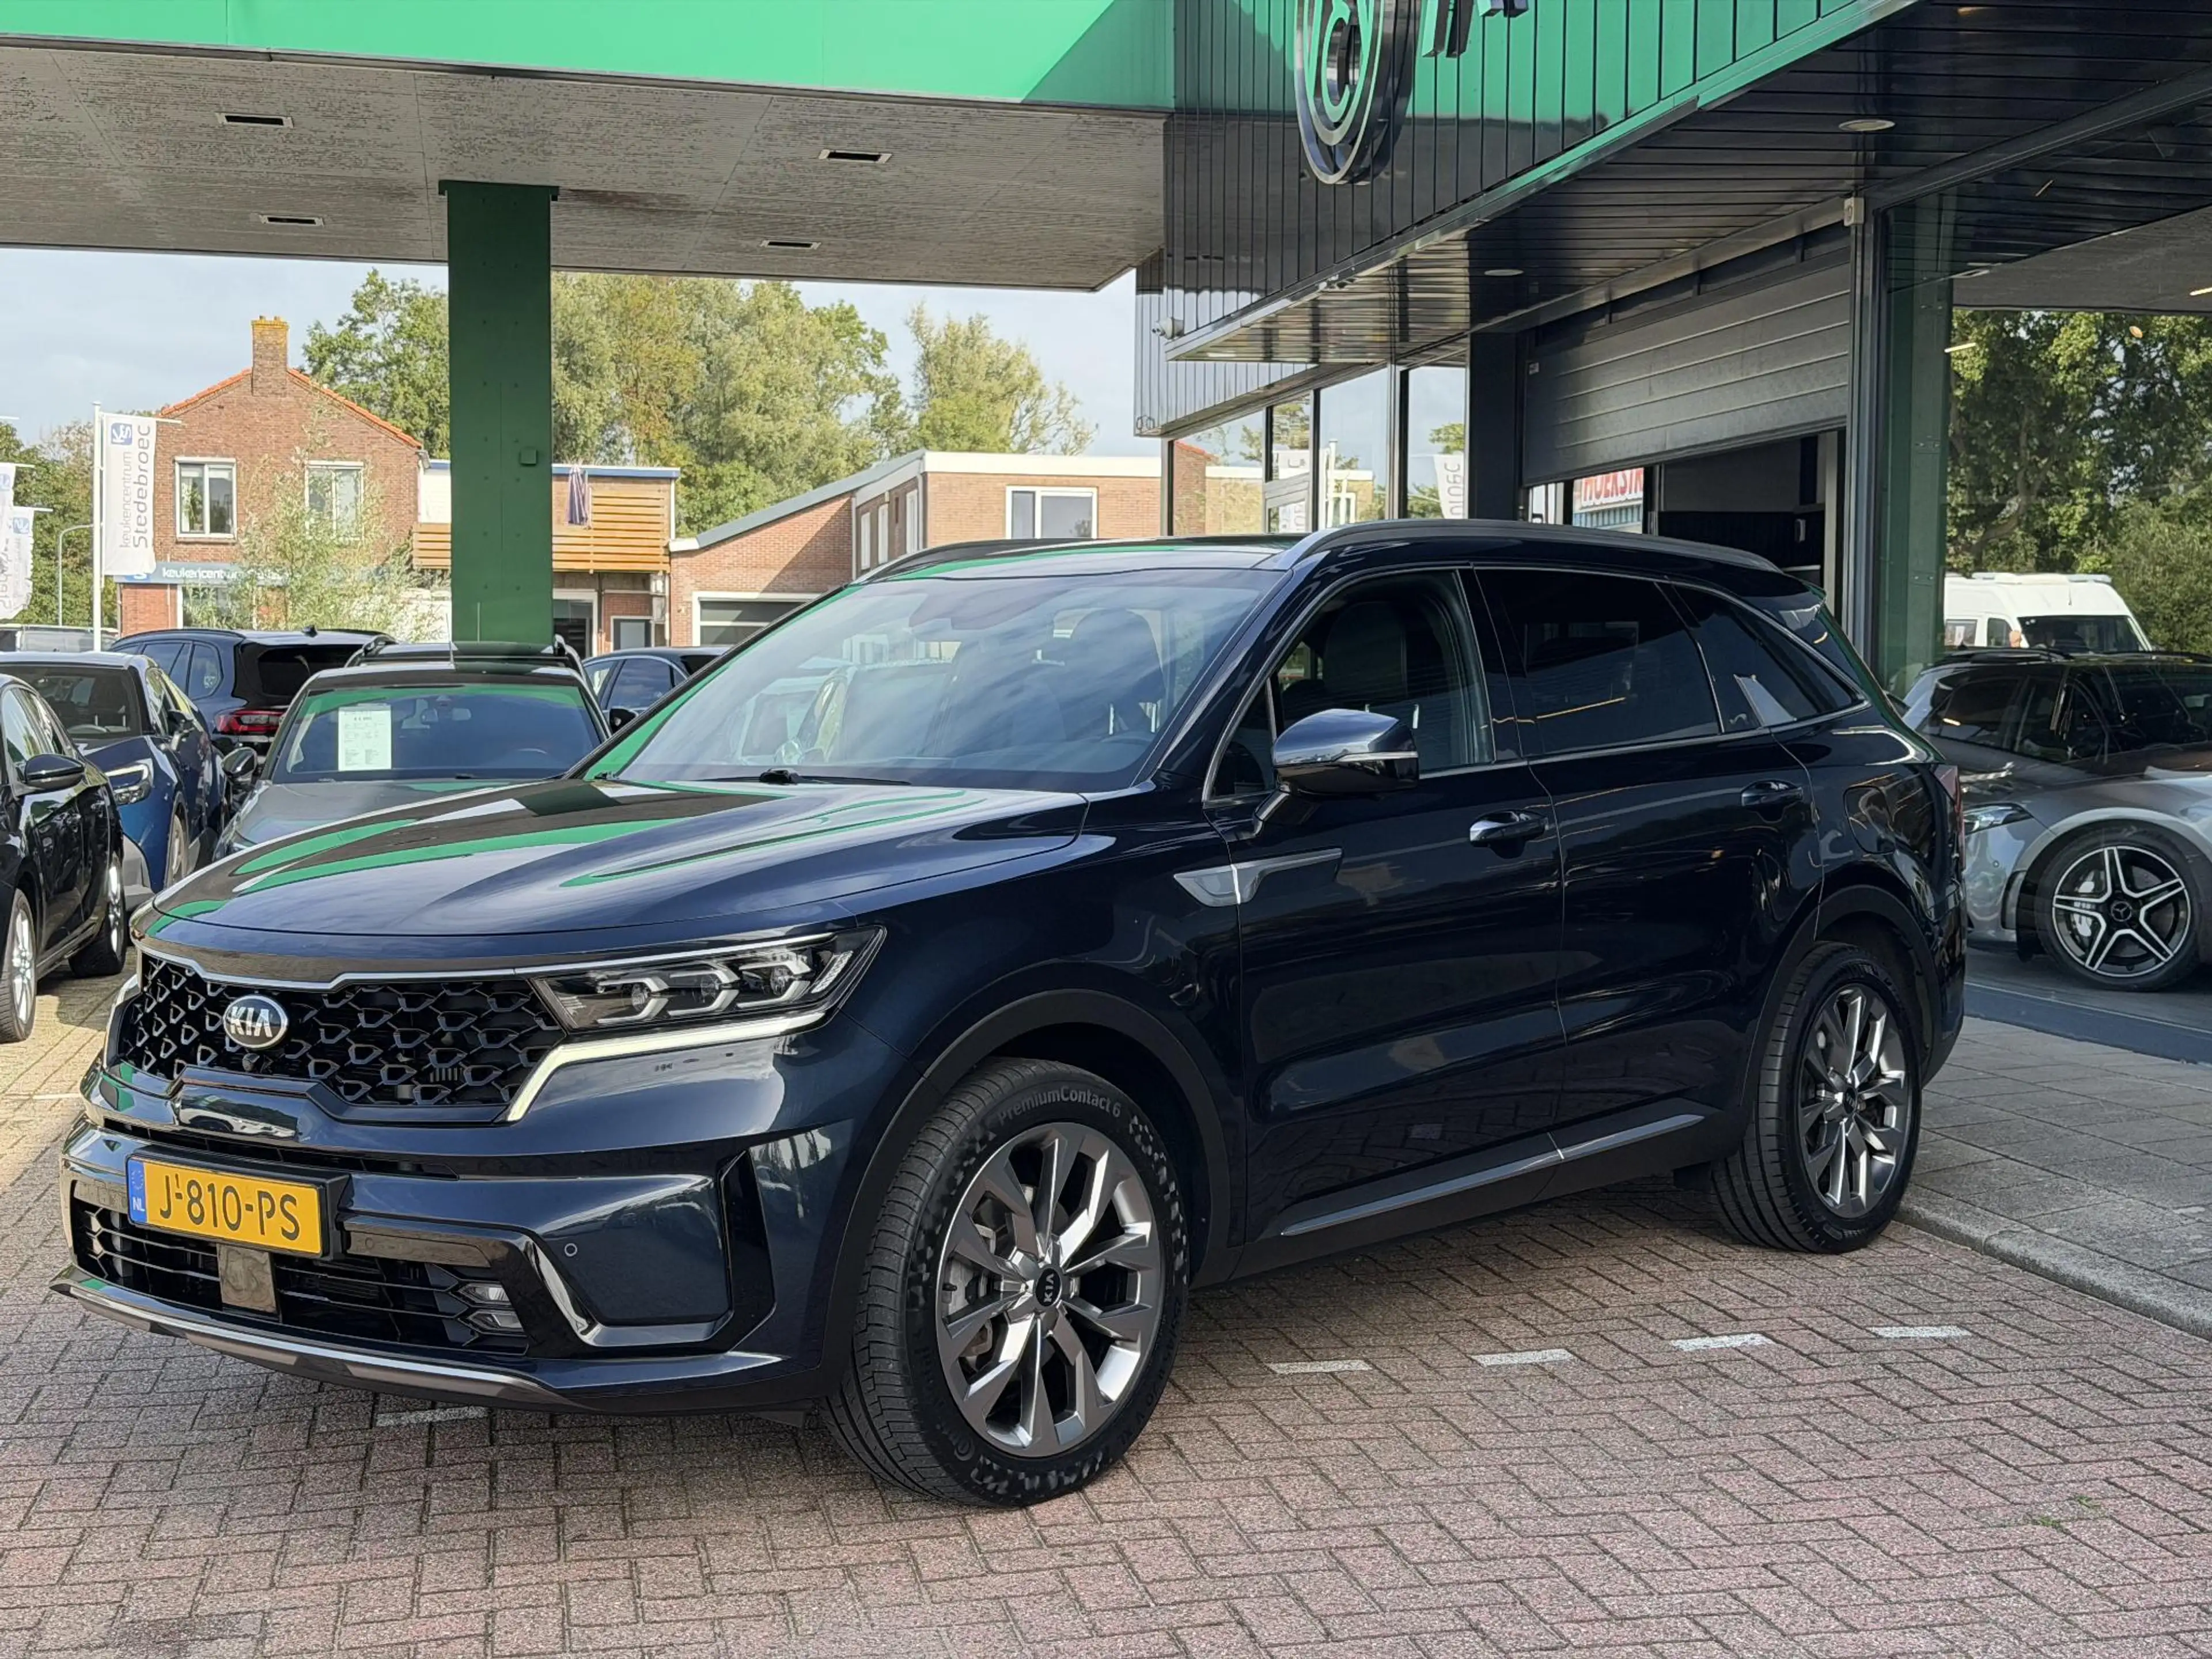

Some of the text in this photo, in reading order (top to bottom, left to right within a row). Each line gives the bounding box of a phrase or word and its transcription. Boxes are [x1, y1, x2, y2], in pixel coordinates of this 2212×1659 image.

[119, 451, 132, 548] keukencentrum
[132, 424, 151, 549] Stedebroec
[231, 1006, 273, 1038] KIA
[997, 1085, 1122, 1126] PremiumContact 6
[132, 1196, 146, 1211] NL
[160, 1173, 301, 1241] J-810-PS
[1044, 1272, 1054, 1302] KIA
